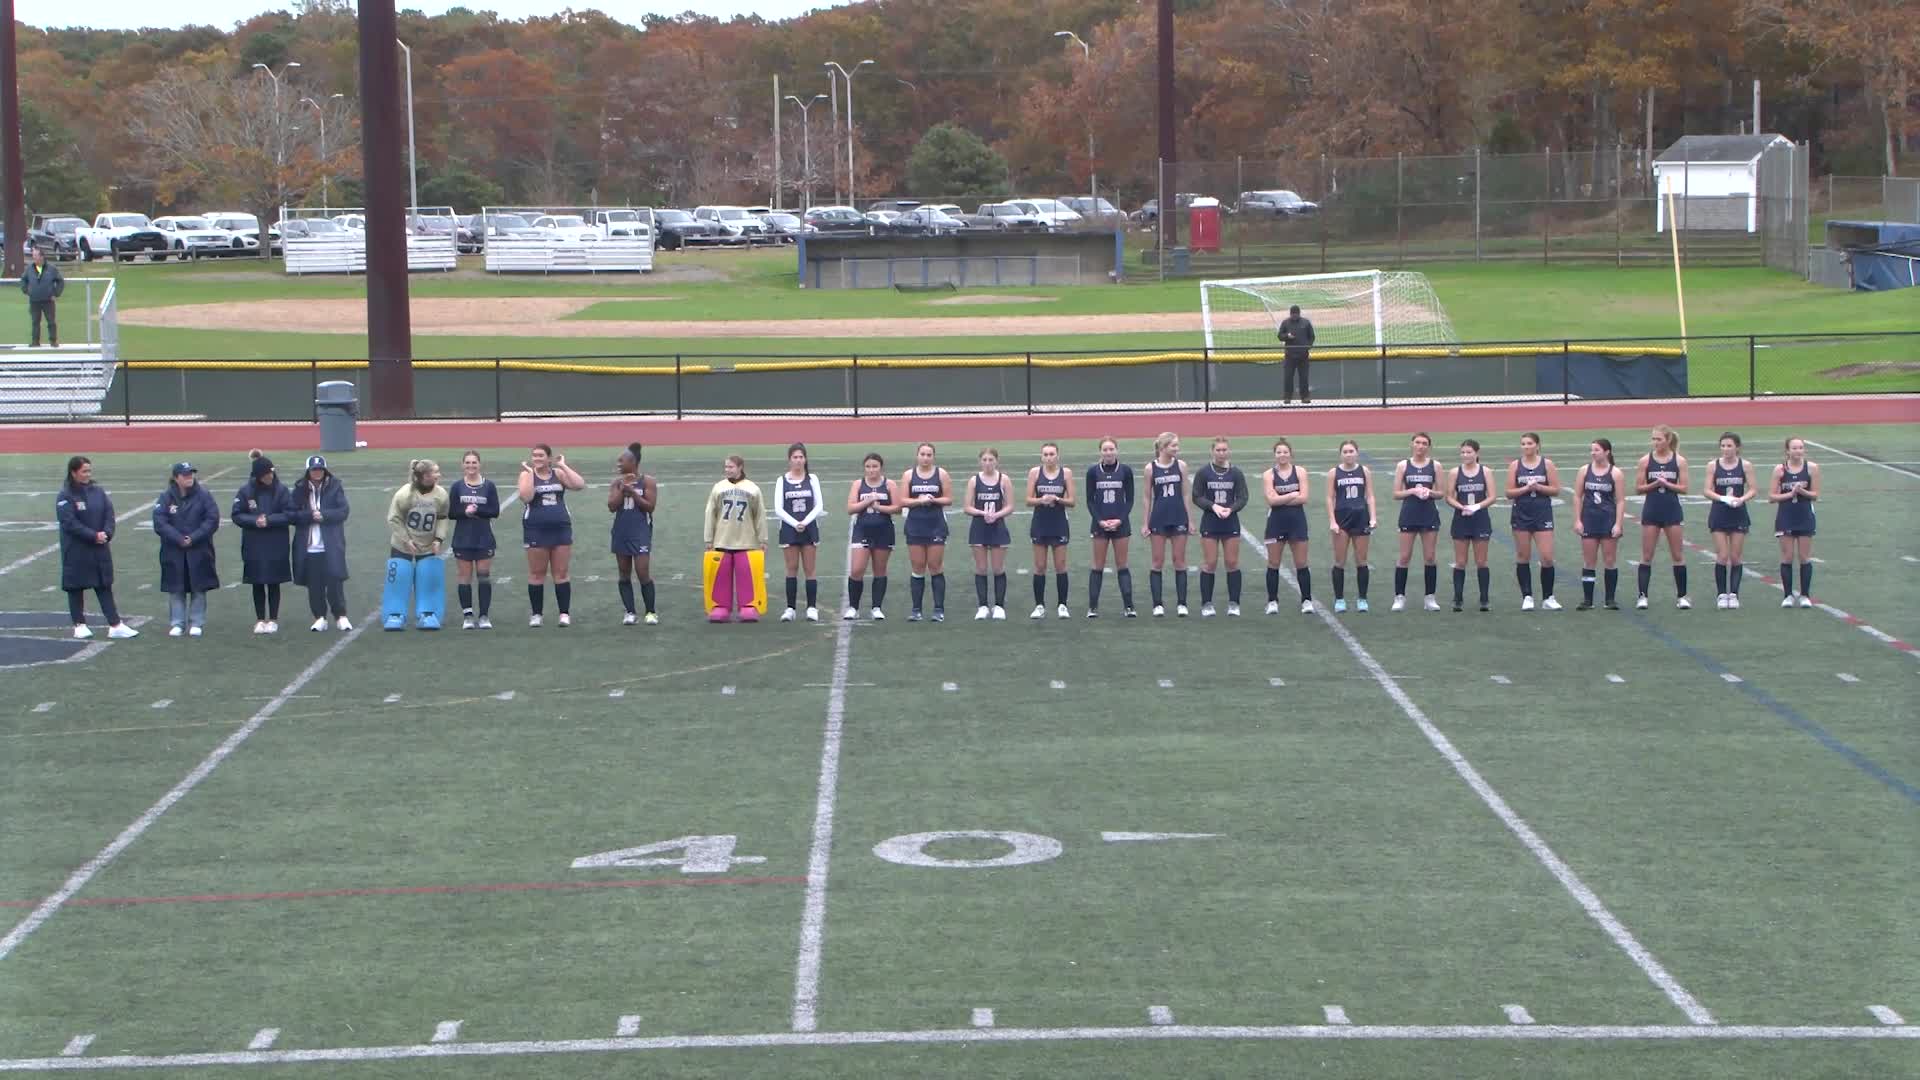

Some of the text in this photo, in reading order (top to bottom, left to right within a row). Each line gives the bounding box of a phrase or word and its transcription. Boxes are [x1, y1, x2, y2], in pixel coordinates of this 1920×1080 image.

[1346, 486, 1358, 500] 10
[723, 499, 748, 521] 77
[407, 511, 436, 532] 88
